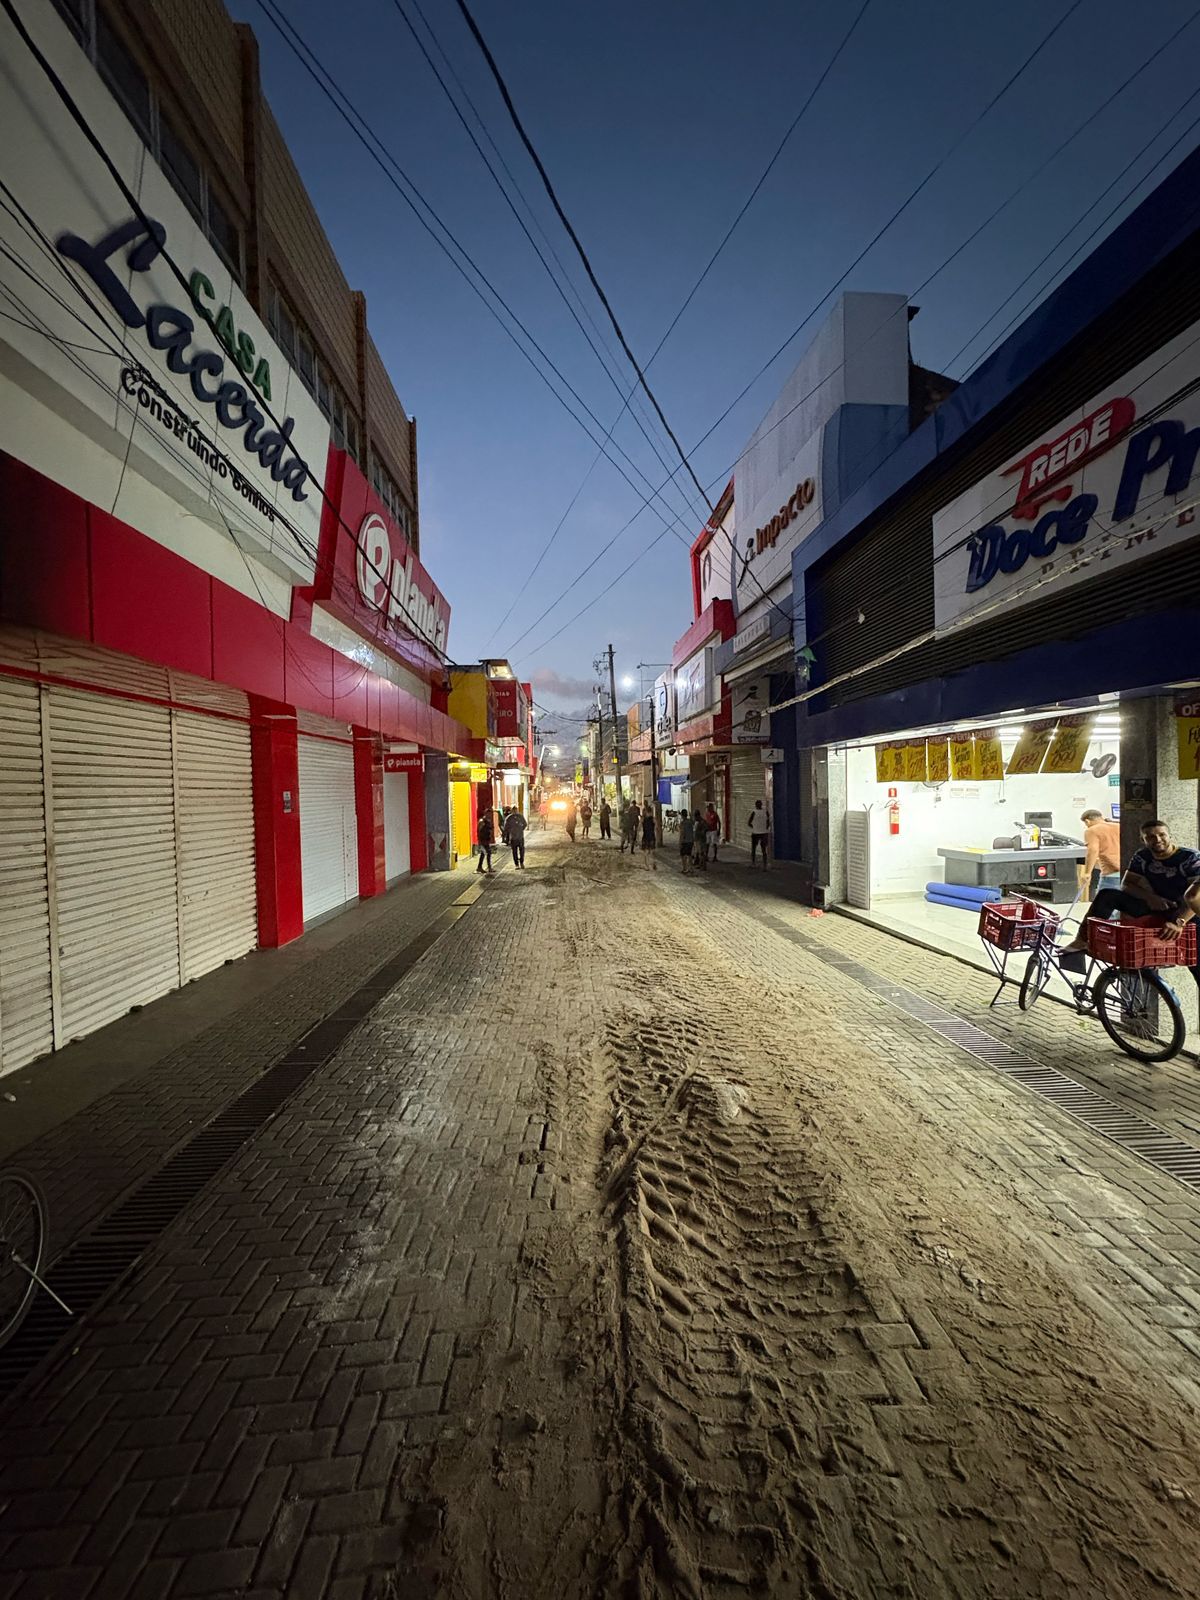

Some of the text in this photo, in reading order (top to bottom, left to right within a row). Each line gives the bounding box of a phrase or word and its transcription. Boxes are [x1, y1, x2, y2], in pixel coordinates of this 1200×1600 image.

[56, 217, 309, 502] Lacerda
[190, 270, 272, 401] CASA
[1028, 408, 1114, 489] REDE
[966, 493, 1099, 593] Doce
[387, 553, 446, 657] planeta
[395, 757, 421, 769] planeta
